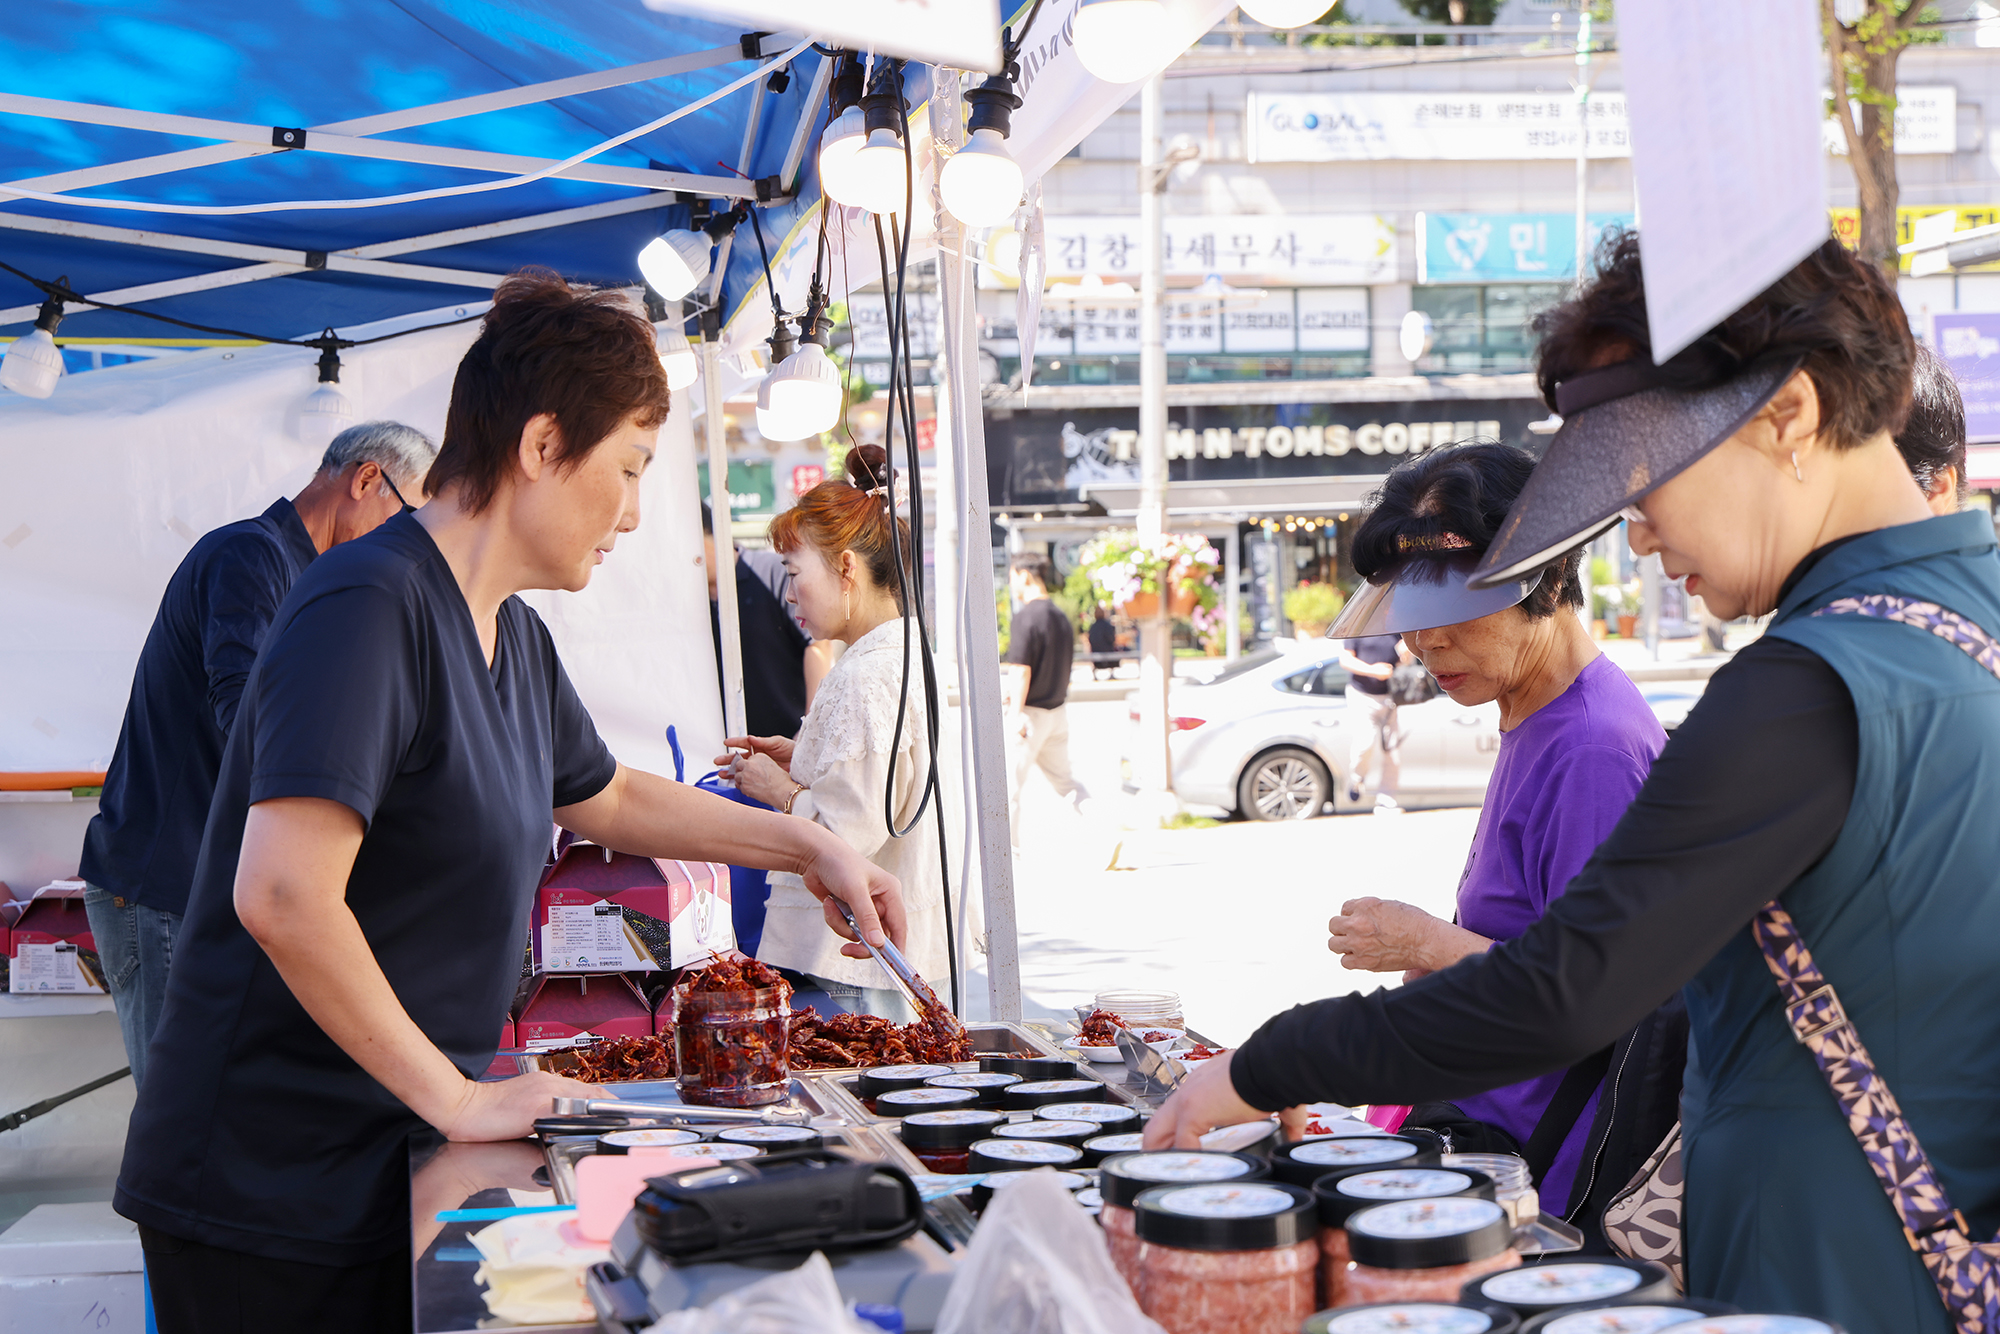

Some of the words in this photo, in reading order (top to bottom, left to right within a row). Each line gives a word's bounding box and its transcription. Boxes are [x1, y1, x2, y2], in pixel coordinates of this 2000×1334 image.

[1108, 429, 1197, 461] TM
[1203, 427, 1233, 460] N
[1240, 424, 1351, 458] TOMS
